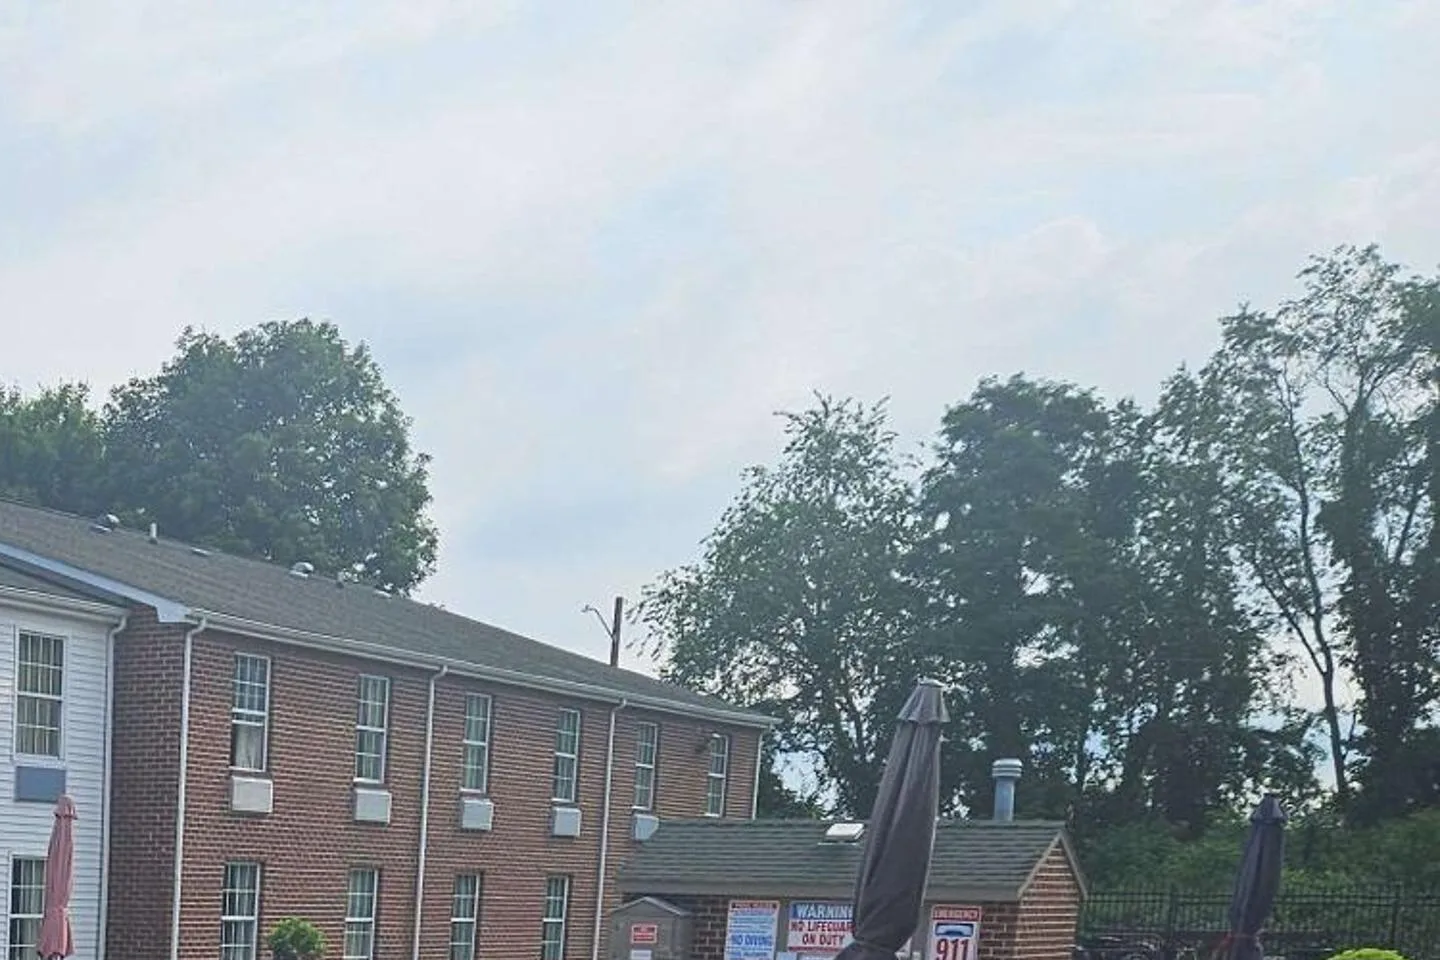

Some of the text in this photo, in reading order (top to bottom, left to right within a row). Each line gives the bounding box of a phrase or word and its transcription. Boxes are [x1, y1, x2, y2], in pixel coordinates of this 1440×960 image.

[791, 921, 856, 932] NO LIFEGUAR
[731, 934, 772, 946] NO DIVING
[802, 933, 845, 946] ON DUTY
